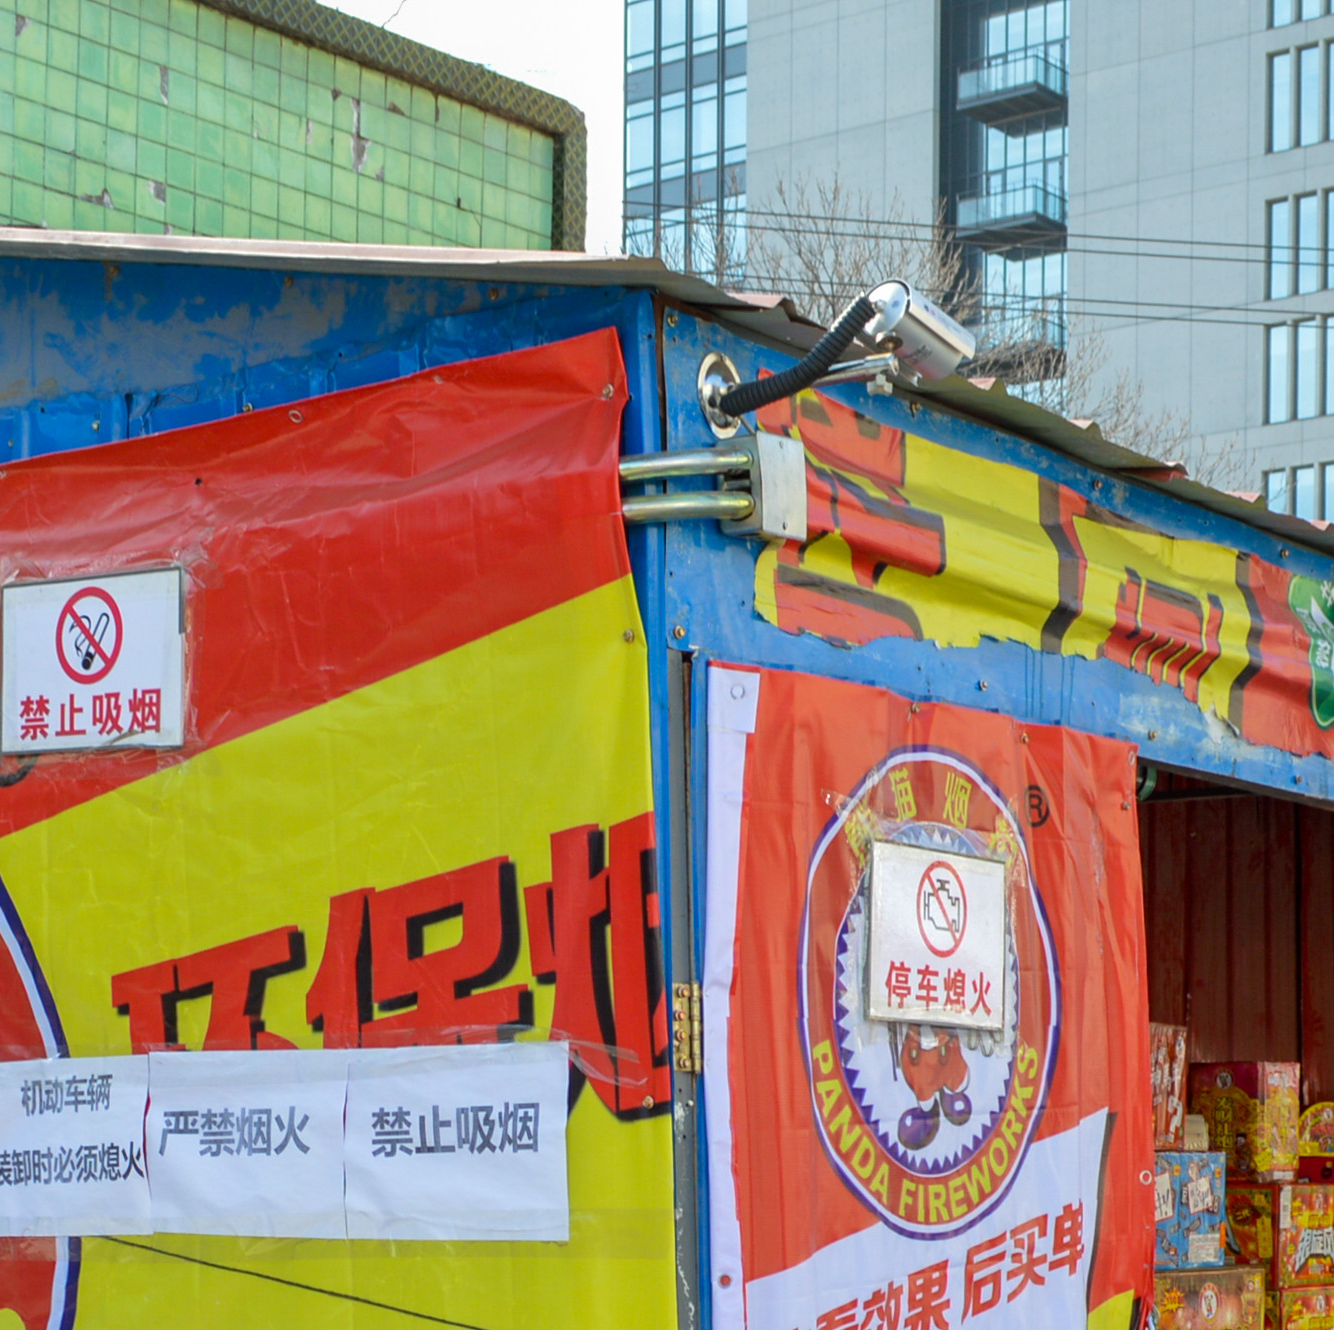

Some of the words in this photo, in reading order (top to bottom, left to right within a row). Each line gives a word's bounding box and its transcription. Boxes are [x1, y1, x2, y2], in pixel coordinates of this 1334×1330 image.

[19, 687, 162, 741] 禁止吸烟
[885, 960, 992, 1015] 停车熄火
[20, 1073, 113, 1112] 机动车辆
[158, 1106, 310, 1157] 严禁烟火
[371, 1101, 541, 1158] 禁止吸烟
[812, 1037, 891, 1206] PANDA
[899, 1041, 1040, 1225] FIREWORKS
[962, 1200, 1085, 1326] 后买单
